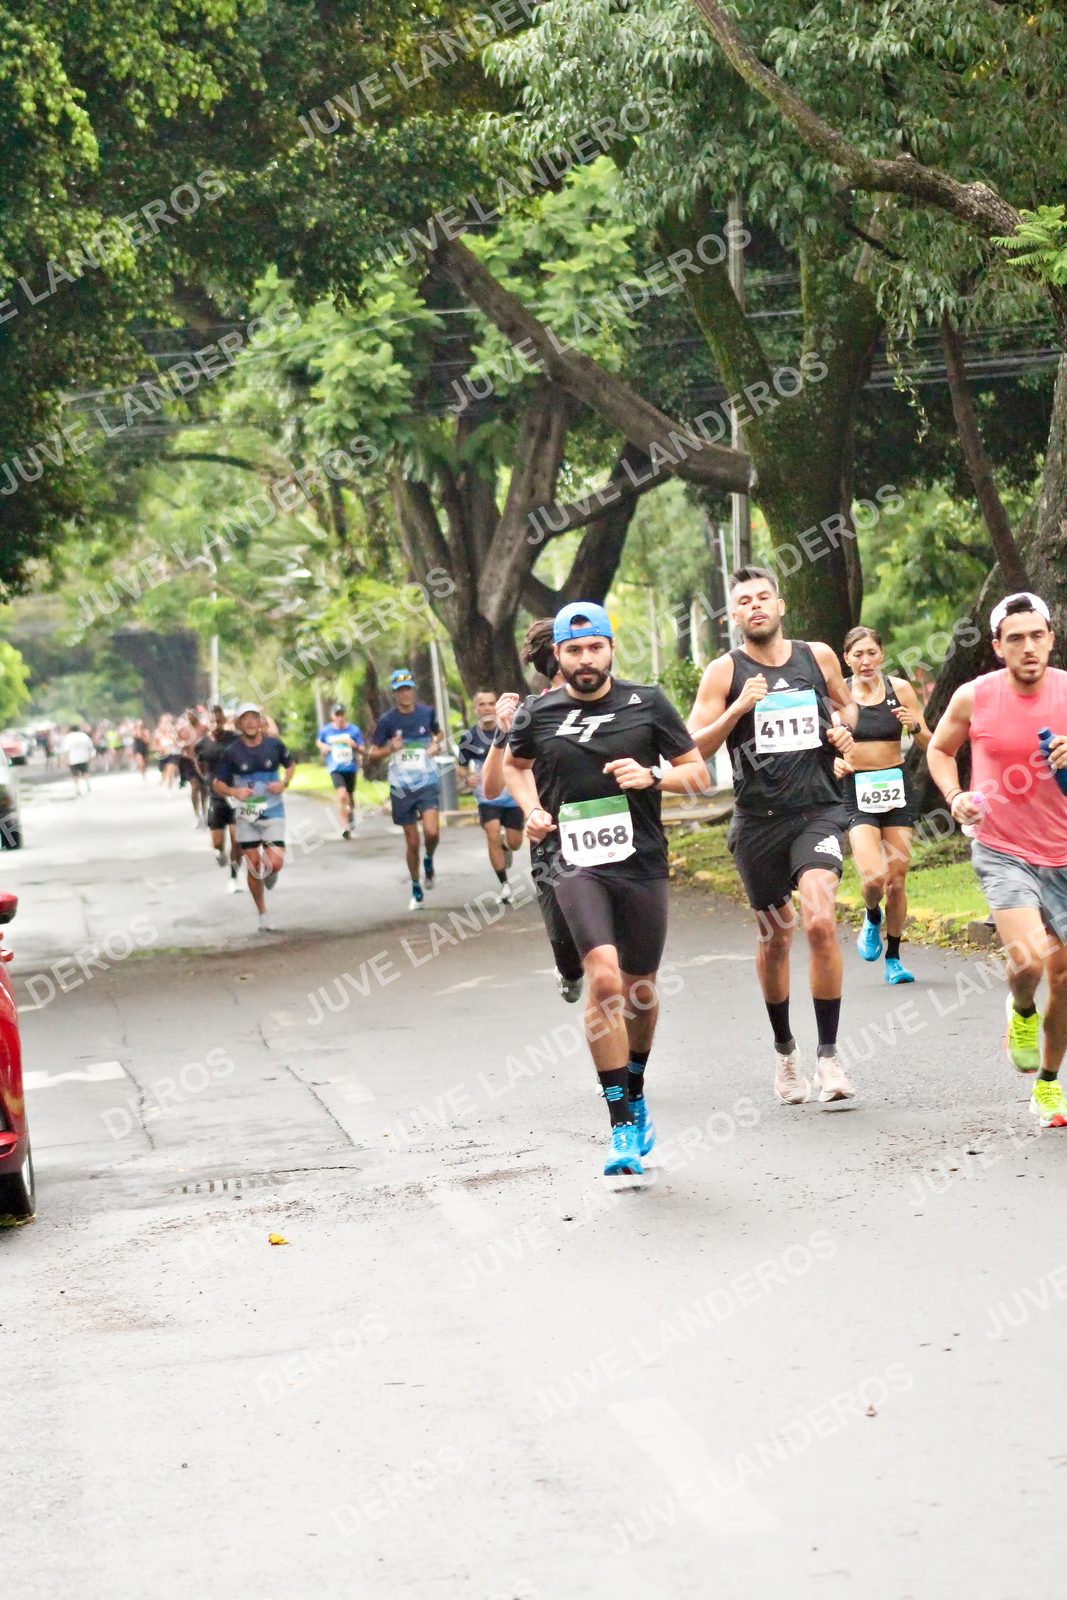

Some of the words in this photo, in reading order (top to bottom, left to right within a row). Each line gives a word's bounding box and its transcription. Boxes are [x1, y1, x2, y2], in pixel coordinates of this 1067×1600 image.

[555, 709, 616, 742] LT
[760, 716, 815, 739] 4113
[860, 788, 901, 804] 4932
[567, 825, 629, 852] 1068
